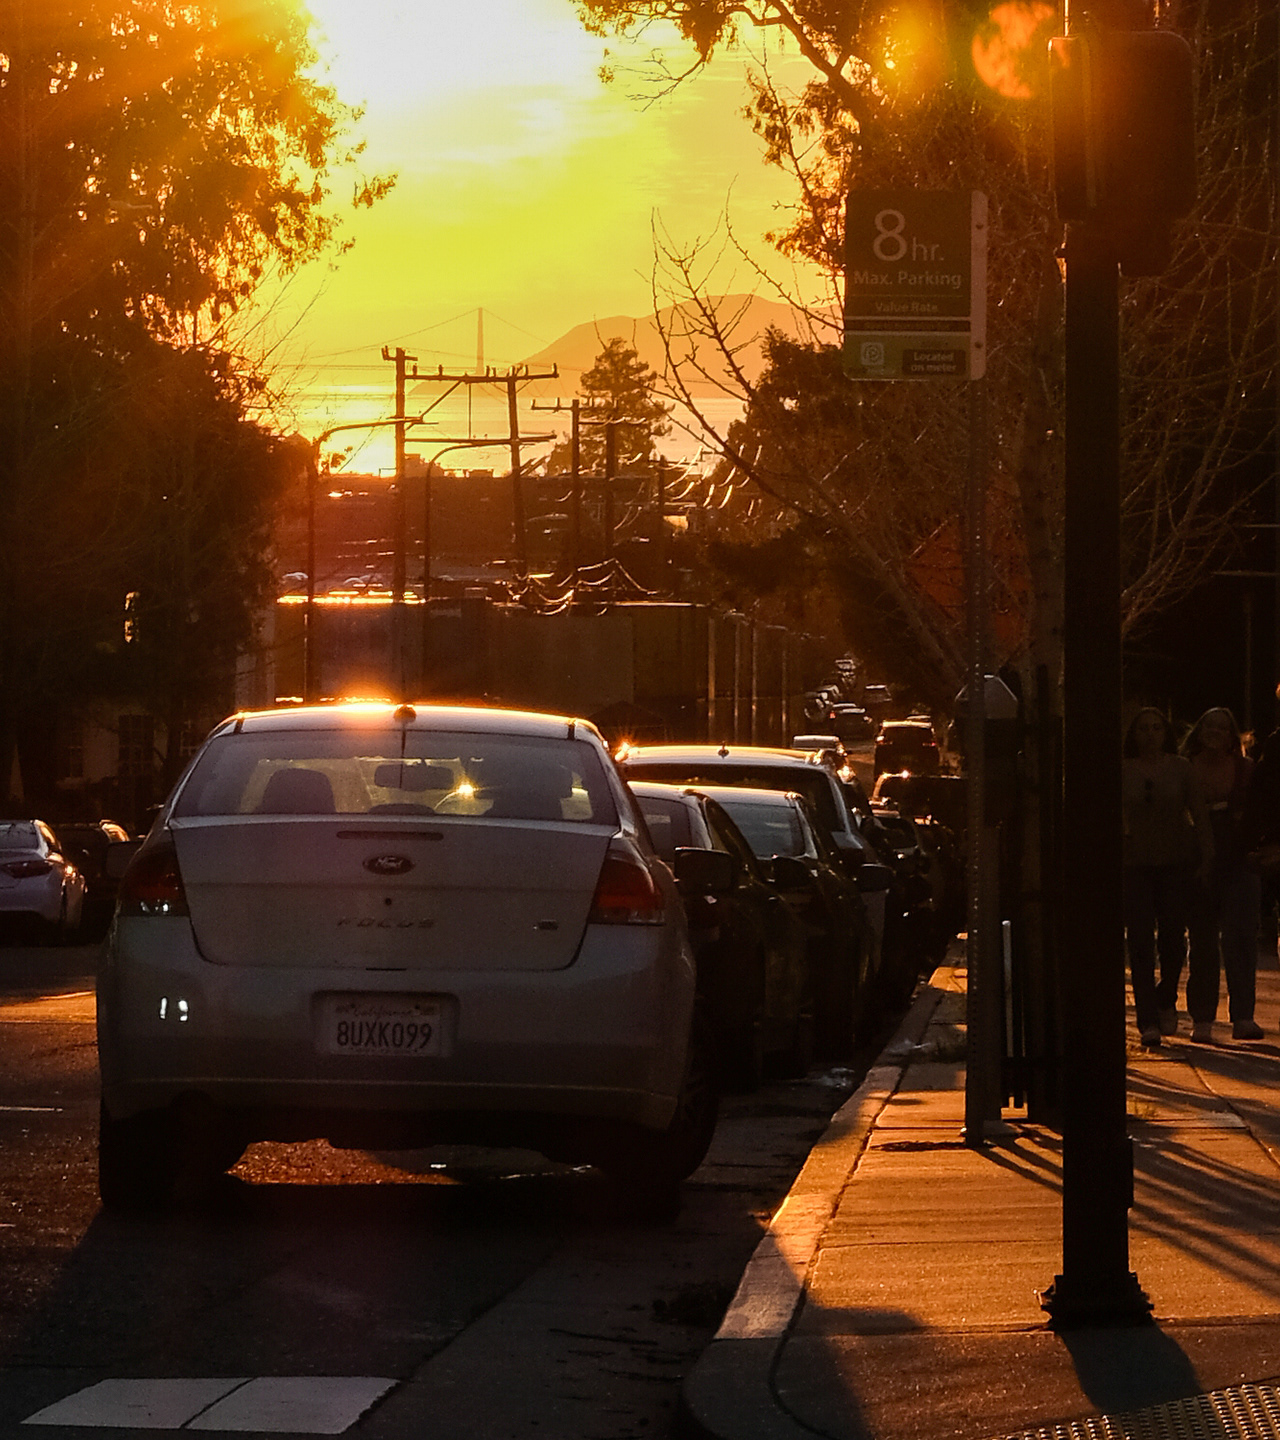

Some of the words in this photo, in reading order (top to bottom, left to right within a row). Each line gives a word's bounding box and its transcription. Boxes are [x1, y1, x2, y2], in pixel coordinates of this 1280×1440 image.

[873, 208, 908, 261] 8
[911, 235, 945, 261] hr.
[853, 270, 893, 285] Max.
[898, 270, 962, 289] Parking
[875, 301, 908, 312] Value
[337, 1021, 432, 1049] 8UXK099
